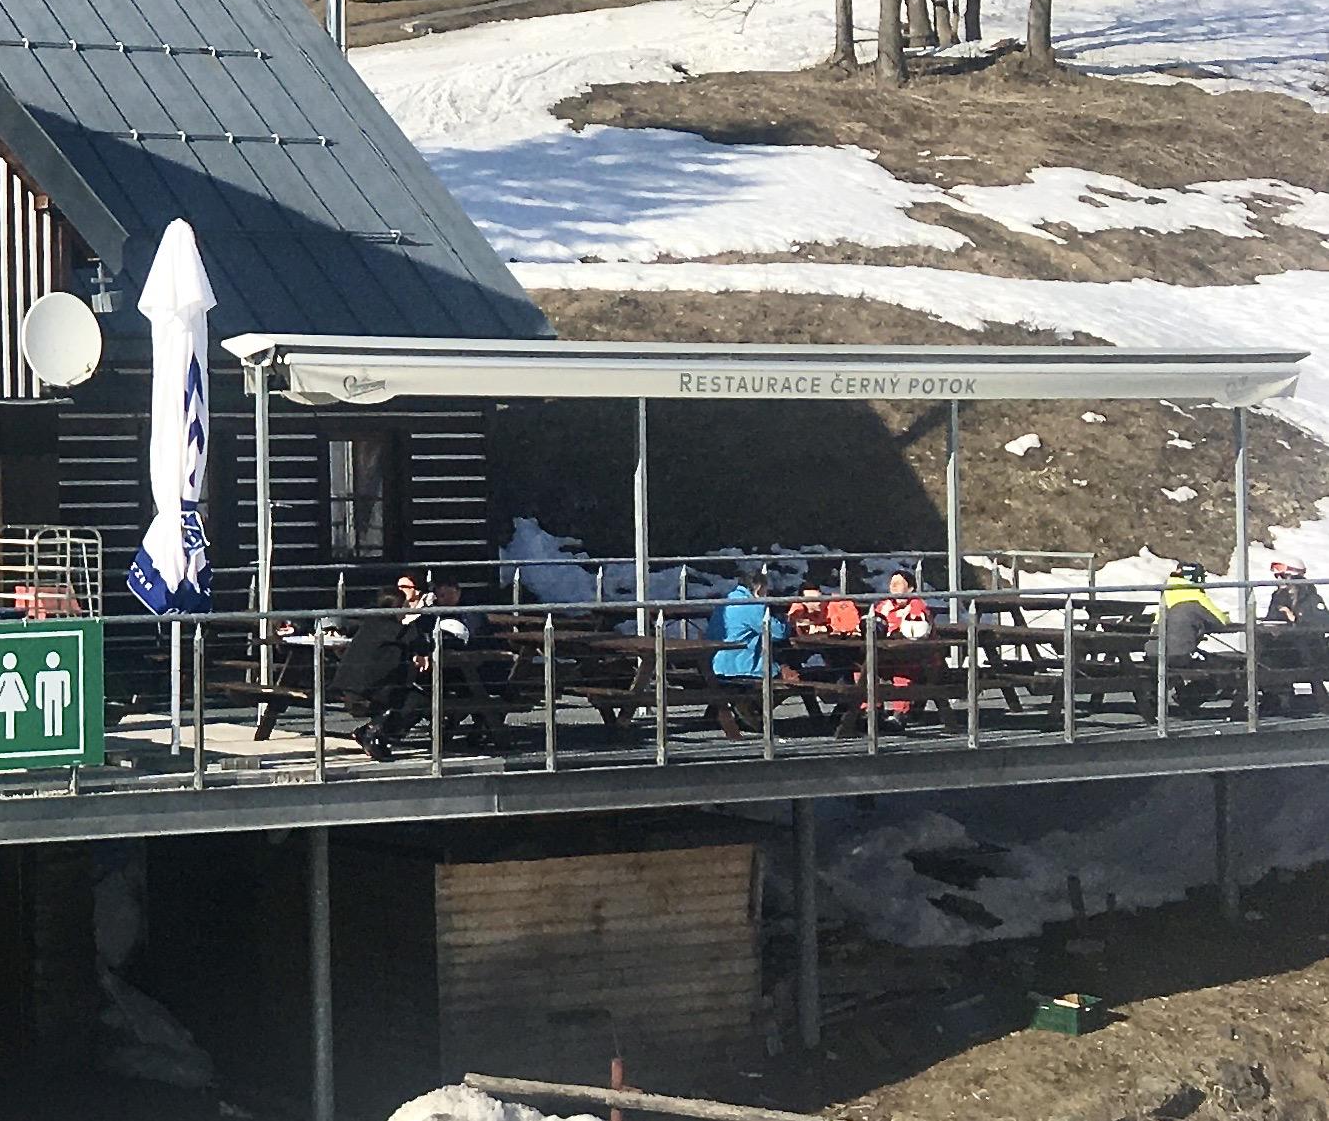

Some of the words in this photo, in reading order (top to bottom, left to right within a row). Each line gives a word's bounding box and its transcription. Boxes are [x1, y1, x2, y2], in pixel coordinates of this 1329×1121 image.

[679, 372, 821, 394] RESTAURACE
[830, 373, 902, 395] ČERNÝ
[907, 377, 978, 395] POTOK
